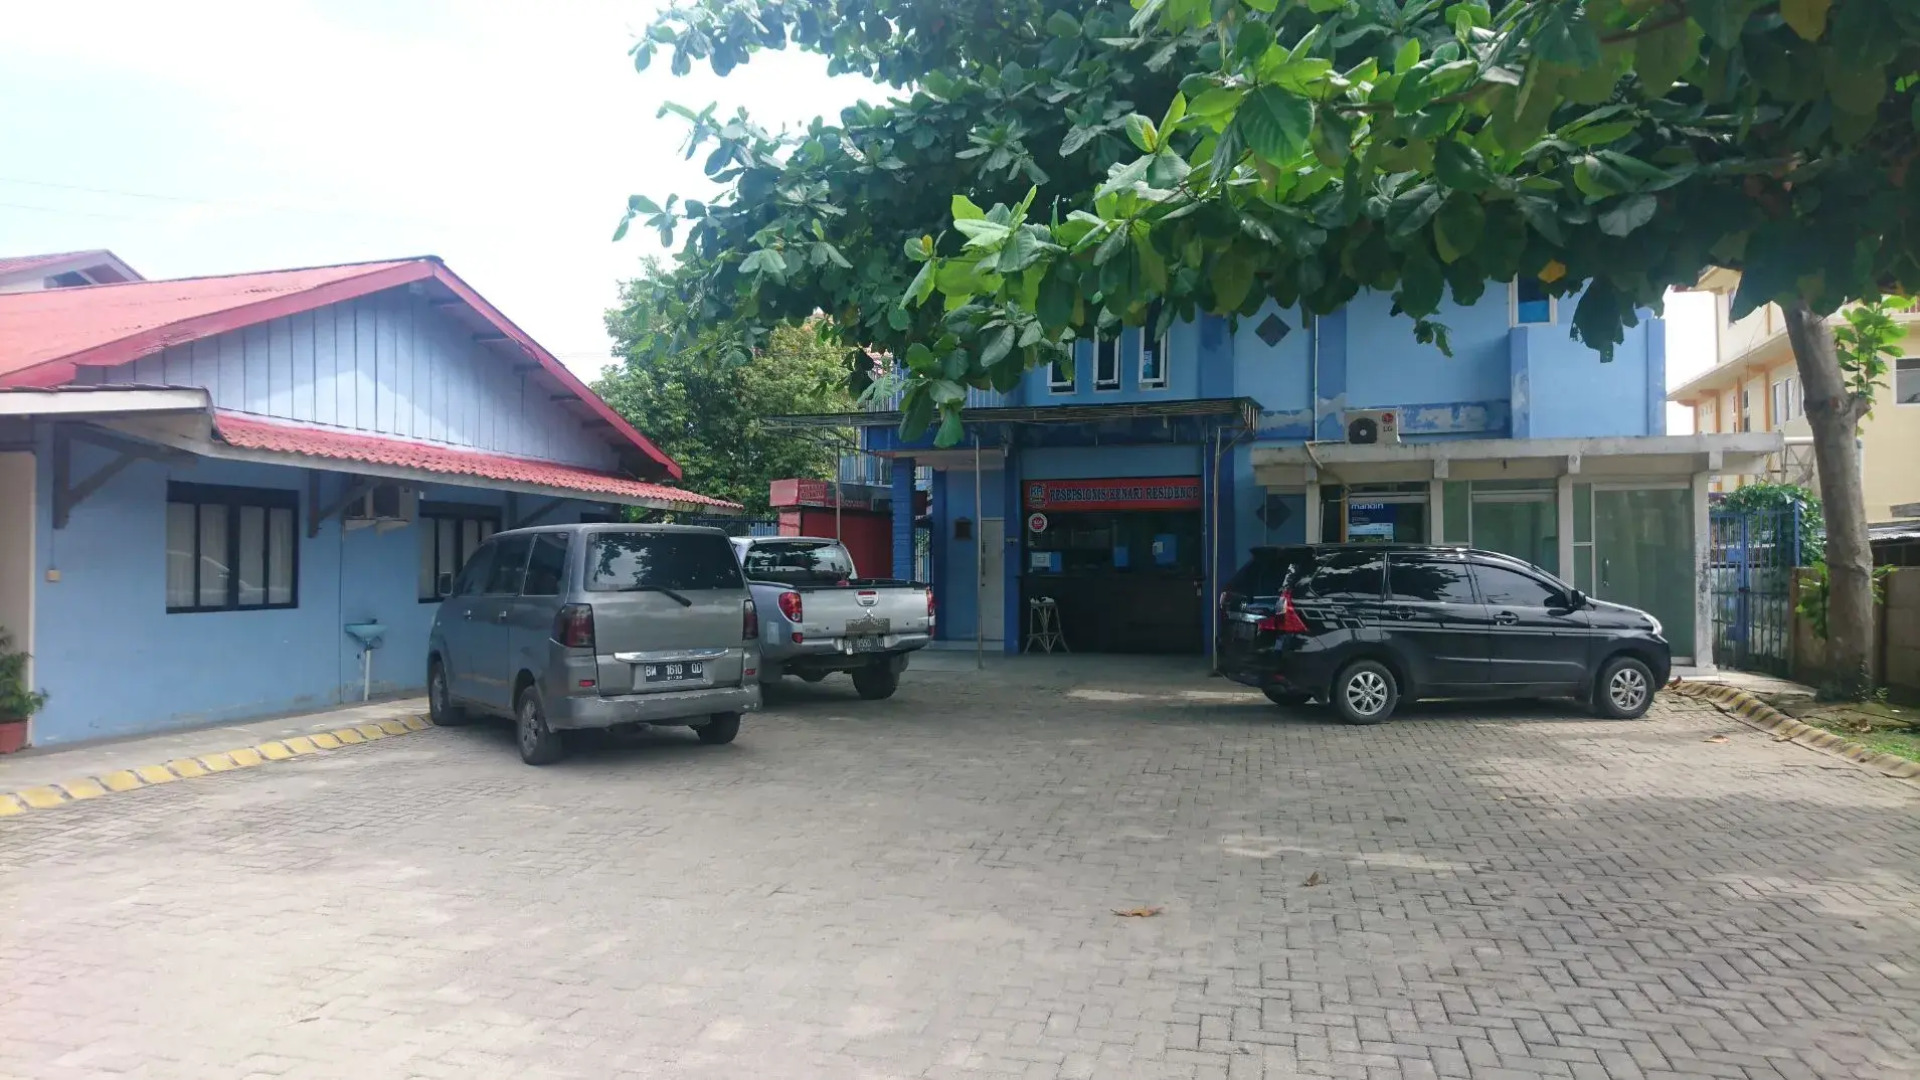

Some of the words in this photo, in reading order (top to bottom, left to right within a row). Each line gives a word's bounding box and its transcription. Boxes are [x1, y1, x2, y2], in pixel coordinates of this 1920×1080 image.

[1108, 487, 1142, 501] KENARI
[1146, 486, 1199, 500] RESIDENCE
[646, 665, 657, 677] BM
[666, 664, 683, 675] 1610
